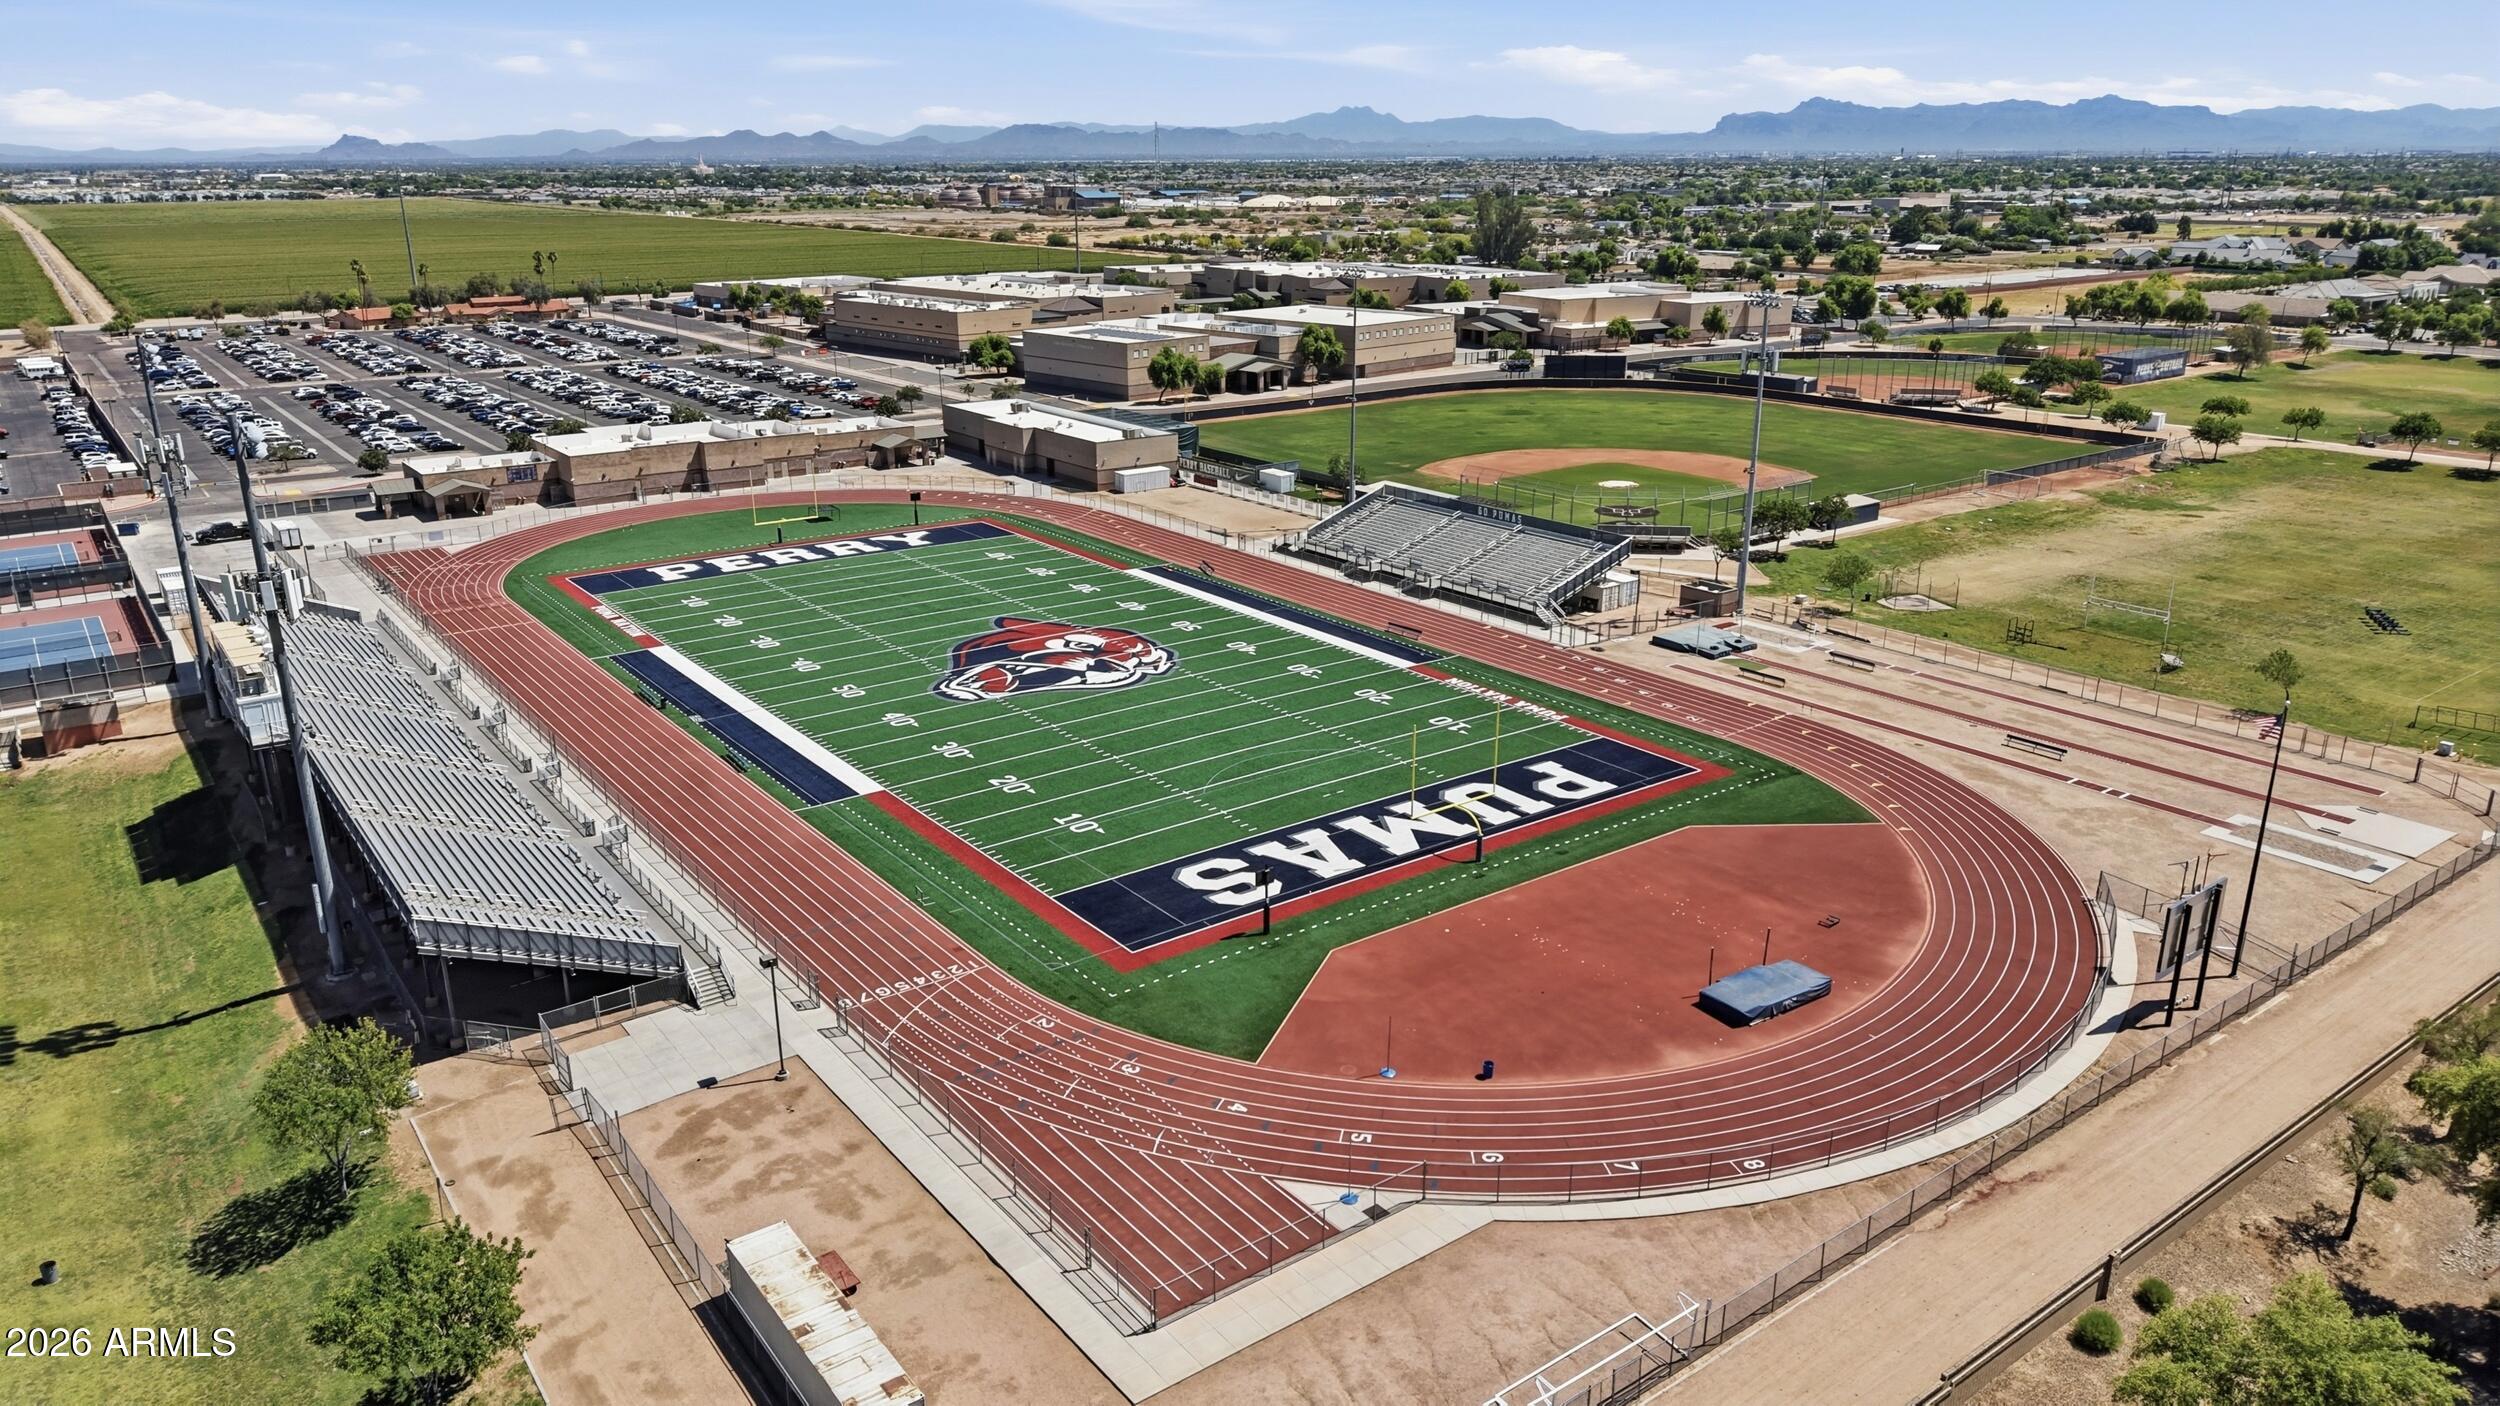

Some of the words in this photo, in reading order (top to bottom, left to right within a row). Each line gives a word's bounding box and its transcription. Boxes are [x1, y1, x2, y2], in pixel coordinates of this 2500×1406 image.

[1179, 457, 1198, 472] PERRY
[1200, 462, 1231, 479] BASEBALL
[1478, 506, 1488, 517] GO
[1492, 509, 1522, 524] PUMAS
[646, 530, 933, 582] PERRY
[681, 597, 709, 608] 10
[714, 614, 744, 628] 20
[1170, 620, 1203, 632] 50
[750, 635, 781, 649] 30
[1226, 641, 1257, 653] 40
[791, 658, 821, 672] 40
[1286, 663, 1323, 678] 30
[832, 684, 866, 699] 50
[1353, 688, 1394, 703] 20
[881, 712, 916, 727] 40
[1428, 716, 1472, 732] 10
[931, 741, 970, 758] 30
[988, 775, 1031, 793] 20
[1053, 813, 1099, 833] 10
[1171, 759, 1619, 907] PUMAS
[931, 970, 947, 980] 3
[947, 964, 963, 975] 2
[894, 981, 911, 992] 5
[912, 976, 926, 986] 4
[875, 986, 892, 997] 6
[860, 992, 874, 1004] 7
[1036, 1017, 1056, 1029] 2
[1121, 1063, 1141, 1075] 3
[1227, 1102, 1248, 1113] 4
[1351, 1132, 1373, 1144] 5
[1481, 1152, 1504, 1163] 6
[1614, 1161, 1640, 1171] 7
[1743, 1159, 1765, 1170] 8
